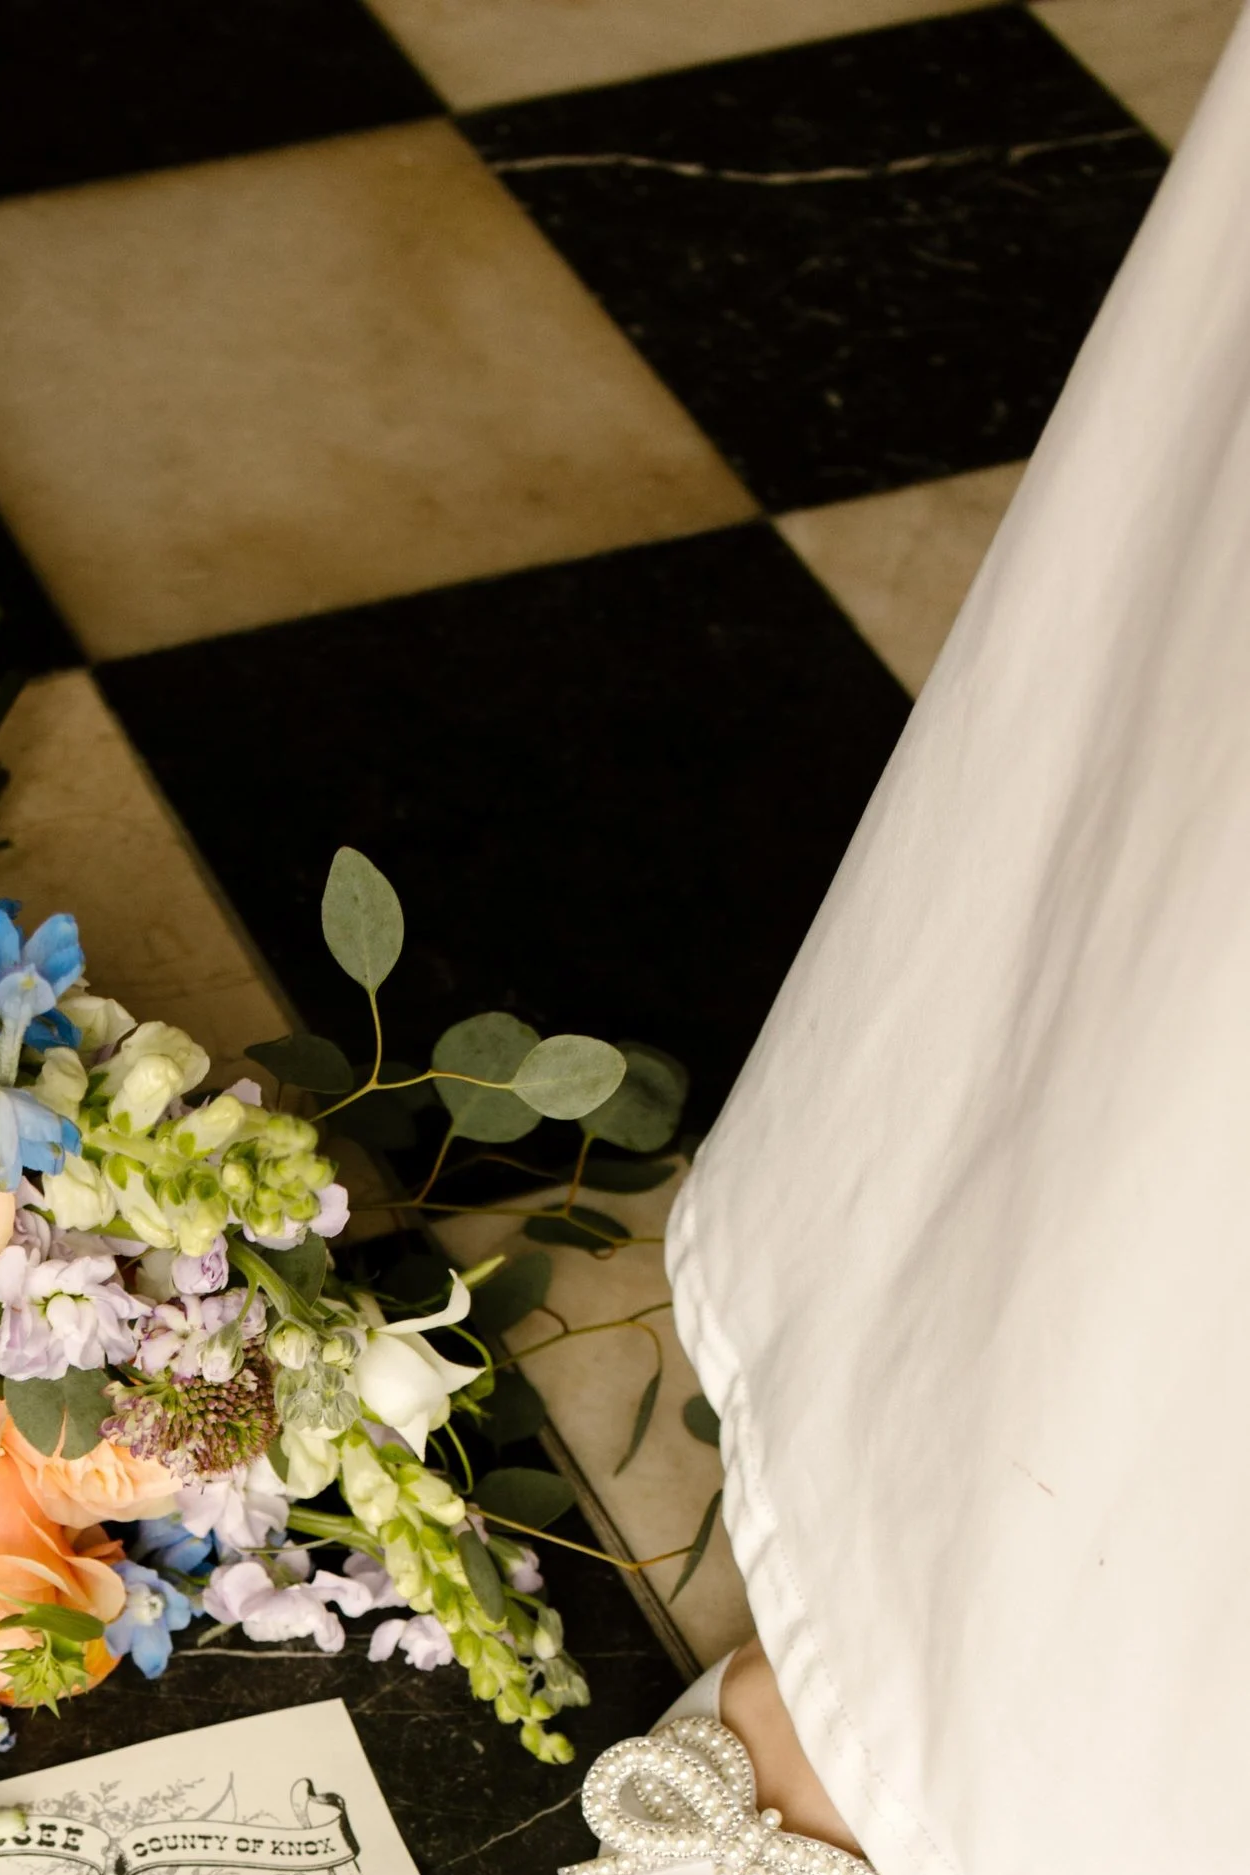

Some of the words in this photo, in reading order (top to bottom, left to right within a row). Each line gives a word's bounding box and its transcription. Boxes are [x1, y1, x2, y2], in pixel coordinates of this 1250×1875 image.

[133, 1834, 228, 1858] COUNTY
[236, 1837, 264, 1853] OF
[270, 1837, 336, 1856] KNOX
